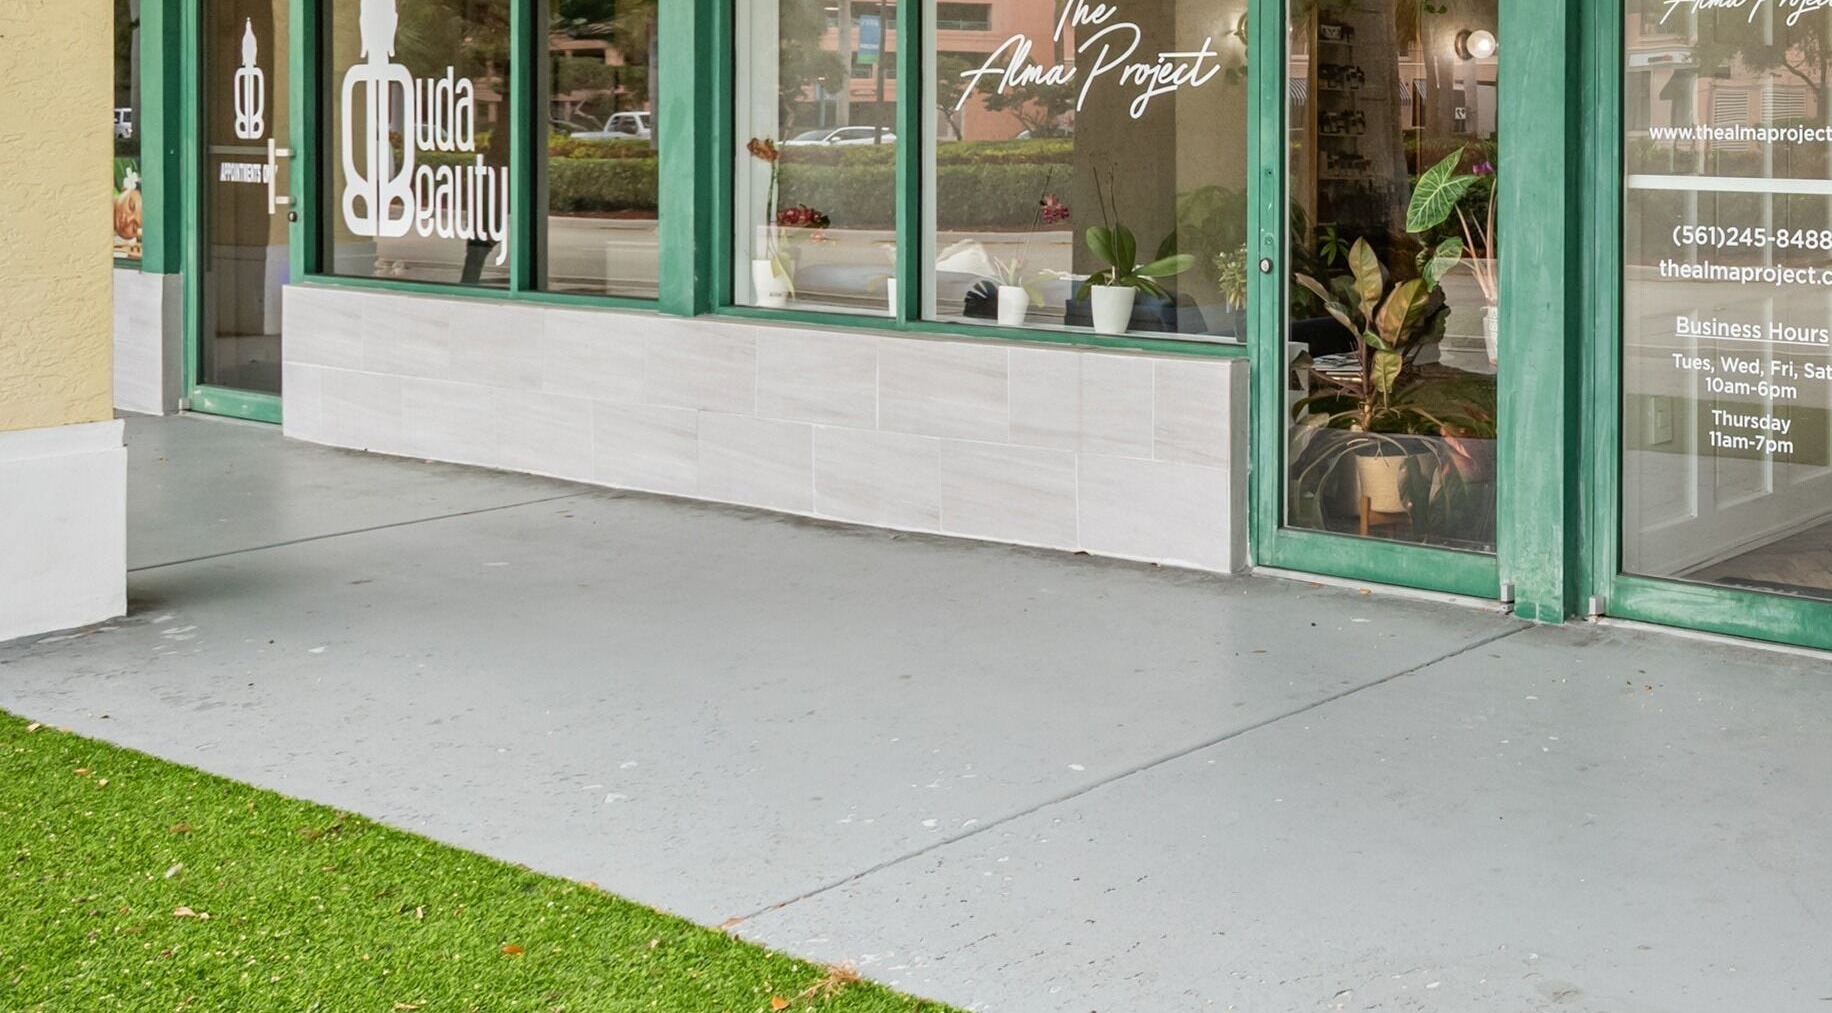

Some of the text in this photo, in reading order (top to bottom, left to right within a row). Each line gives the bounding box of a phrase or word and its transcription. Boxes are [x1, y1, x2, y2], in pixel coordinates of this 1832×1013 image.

[954, 22, 1221, 119] Alma Project
[1675, 316, 1830, 343] Business Hours
[1672, 353, 1832, 380] Tues, Wed, Fri, Sat
[1705, 377, 1797, 400] 10am-6pm
[1711, 409, 1792, 435] Thursday
[1708, 430, 1794, 455] 11am-7pm
